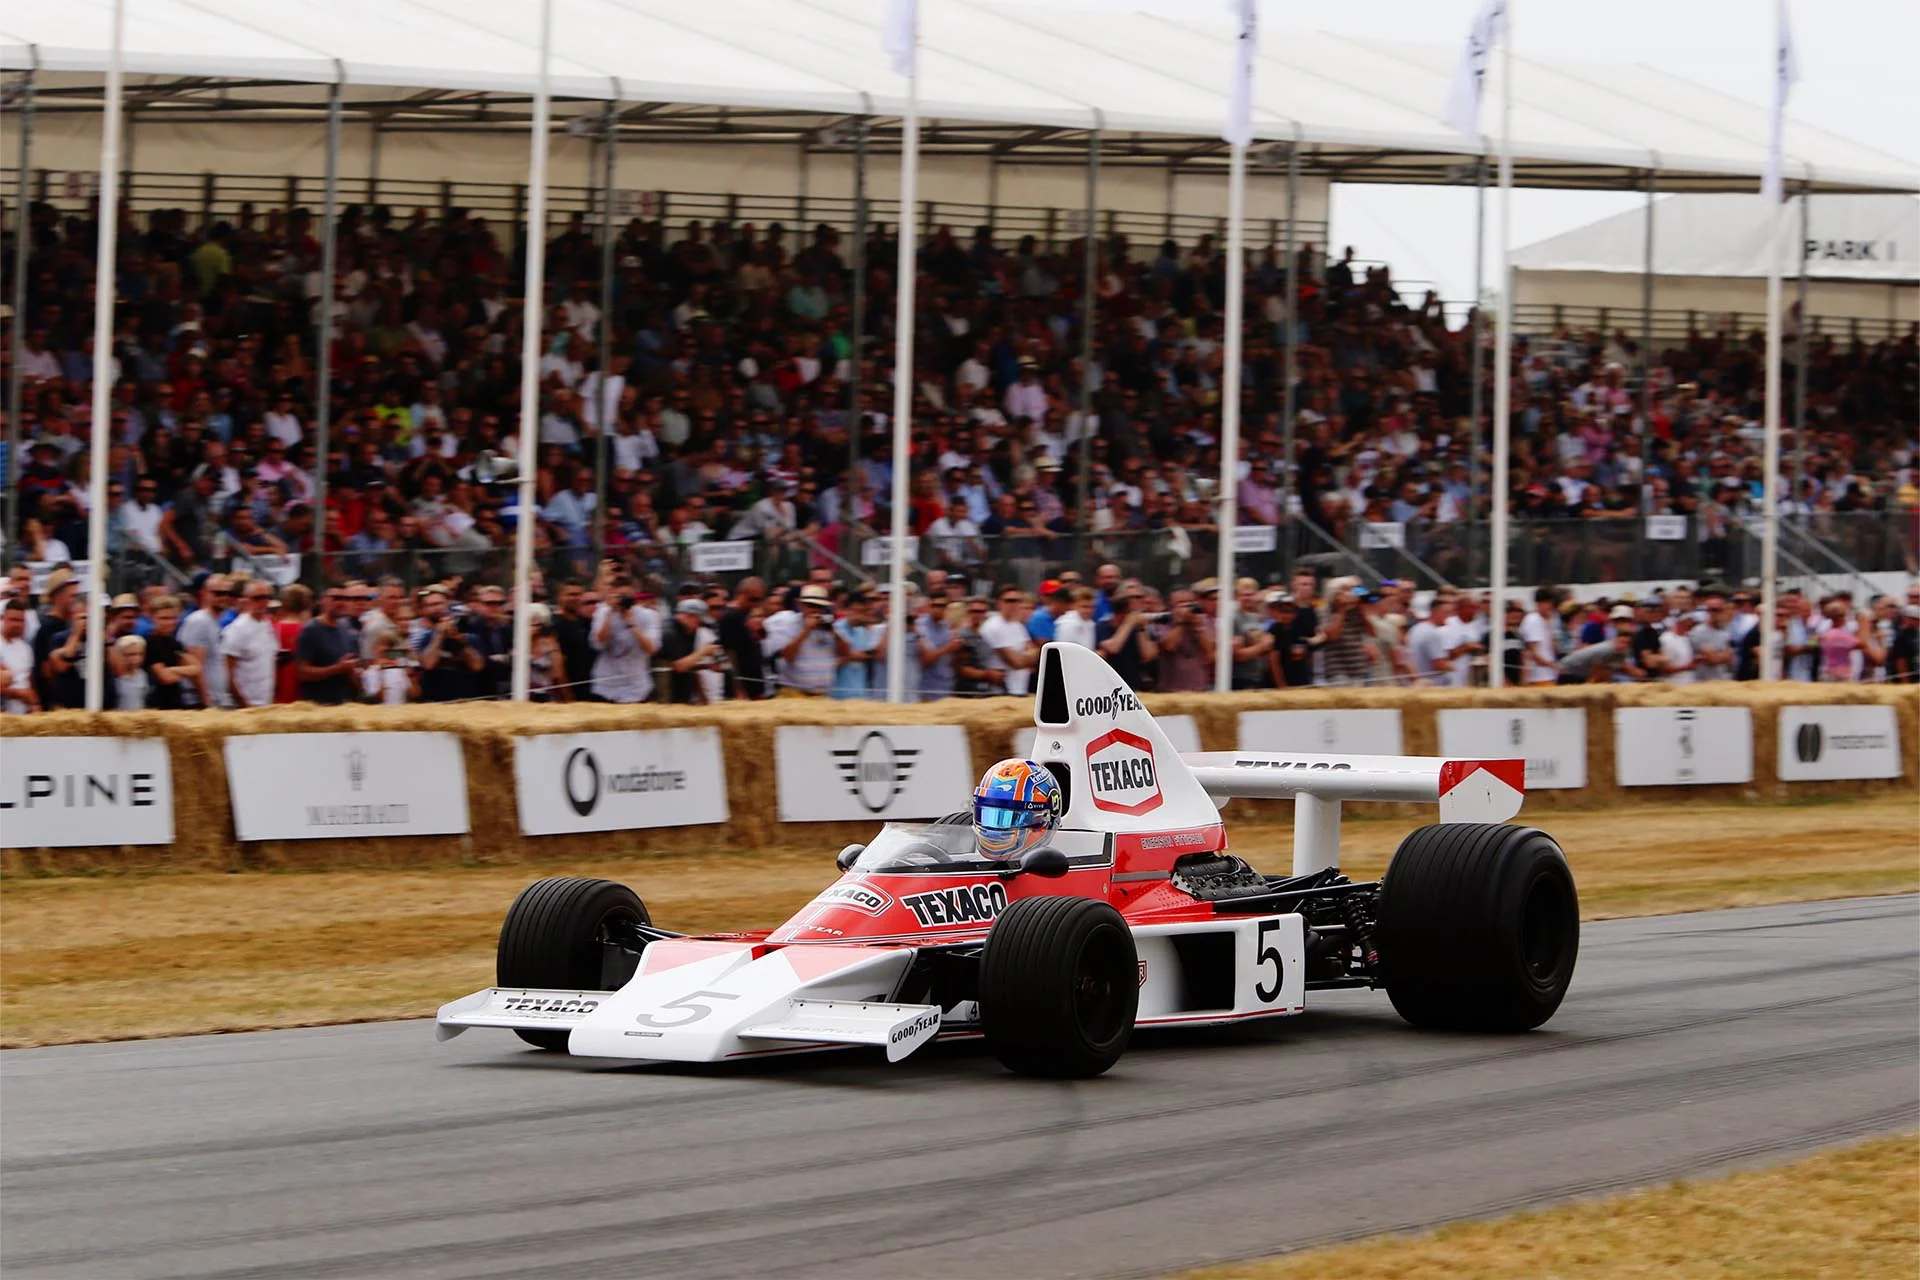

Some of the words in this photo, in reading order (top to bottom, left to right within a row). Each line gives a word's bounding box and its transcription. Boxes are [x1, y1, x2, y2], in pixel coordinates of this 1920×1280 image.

[1803, 240, 1879, 261] PARK
[1076, 690, 1142, 717] GOODYEA
[1091, 758, 1155, 791] TEXACO
[822, 889, 881, 908] XACO
[903, 884, 1007, 926] TEXACO
[1255, 919, 1284, 1003] 5
[504, 997, 599, 1014] TEXACO
[635, 990, 741, 1028] 5
[891, 1013, 940, 1044] GOODYEAR
